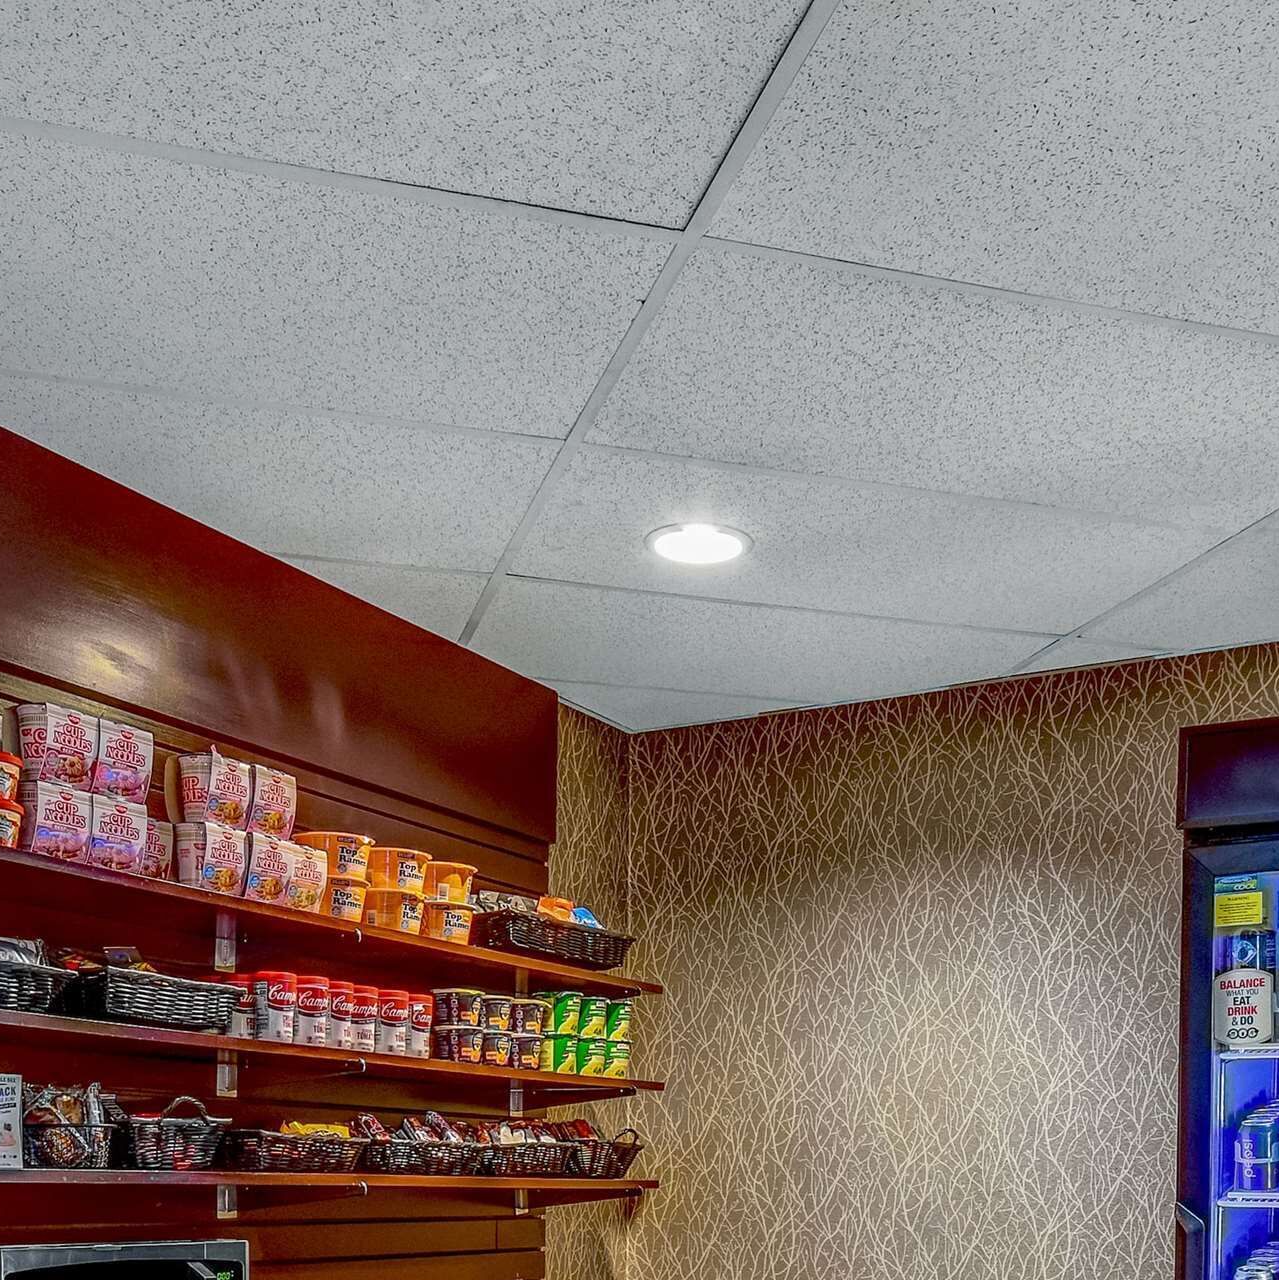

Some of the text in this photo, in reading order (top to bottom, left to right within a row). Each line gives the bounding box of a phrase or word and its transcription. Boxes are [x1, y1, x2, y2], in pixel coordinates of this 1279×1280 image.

[63, 724, 86, 739] CUP
[53, 730, 92, 753] NOODLES
[116, 738, 138, 754] CUP
[106, 746, 146, 767] NOODLES
[182, 776, 199, 790] UP
[225, 772, 242, 784] CUP
[54, 800, 78, 816] CUP
[44, 808, 86, 828] NOODLES
[110, 814, 132, 828] CUP
[99, 821, 140, 840] NOODLES
[147, 831, 160, 844] UP
[339, 846, 358, 857] Top
[399, 860, 416, 873] Top
[332, 888, 352, 899] Top
[402, 903, 418, 914] Top
[402, 911, 420, 922] Ram
[444, 911, 463, 922] Top
[1220, 978, 1266, 990] BALANCE
[1226, 988, 1260, 996] WHAT YOU
[1232, 996, 1250, 1006] EAT
[1228, 1006, 1258, 1016] DRINK
[1232, 1016, 1254, 1026] & DO
[1242, 1138, 1256, 1178] pepsi
